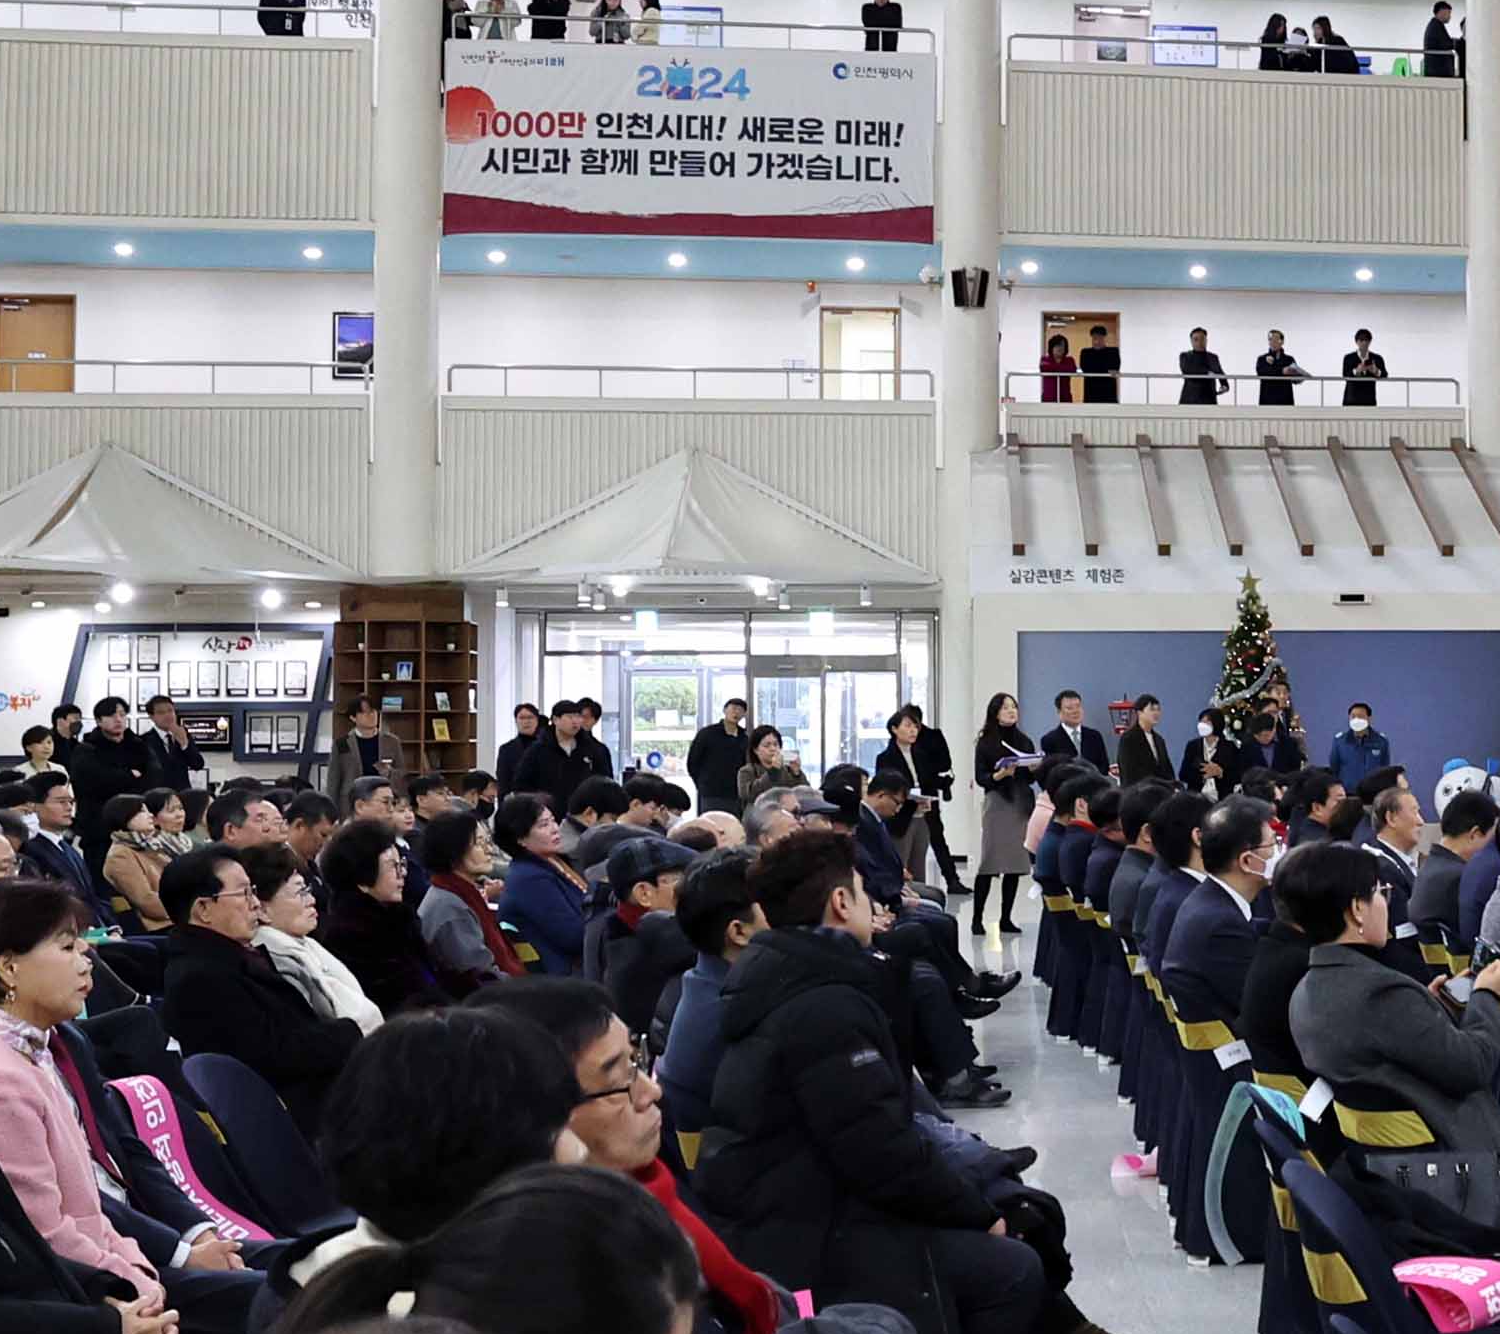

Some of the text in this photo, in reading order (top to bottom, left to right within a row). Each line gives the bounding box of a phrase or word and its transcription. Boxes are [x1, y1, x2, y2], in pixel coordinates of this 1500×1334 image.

[476, 110, 906, 147] 1000만 인천시대! 새로운 미래!
[481, 147, 901, 184] 시민과 함께 만들어 가겠습니다.
[1009, 568, 1125, 584] 실감콘텐츠 체험존
